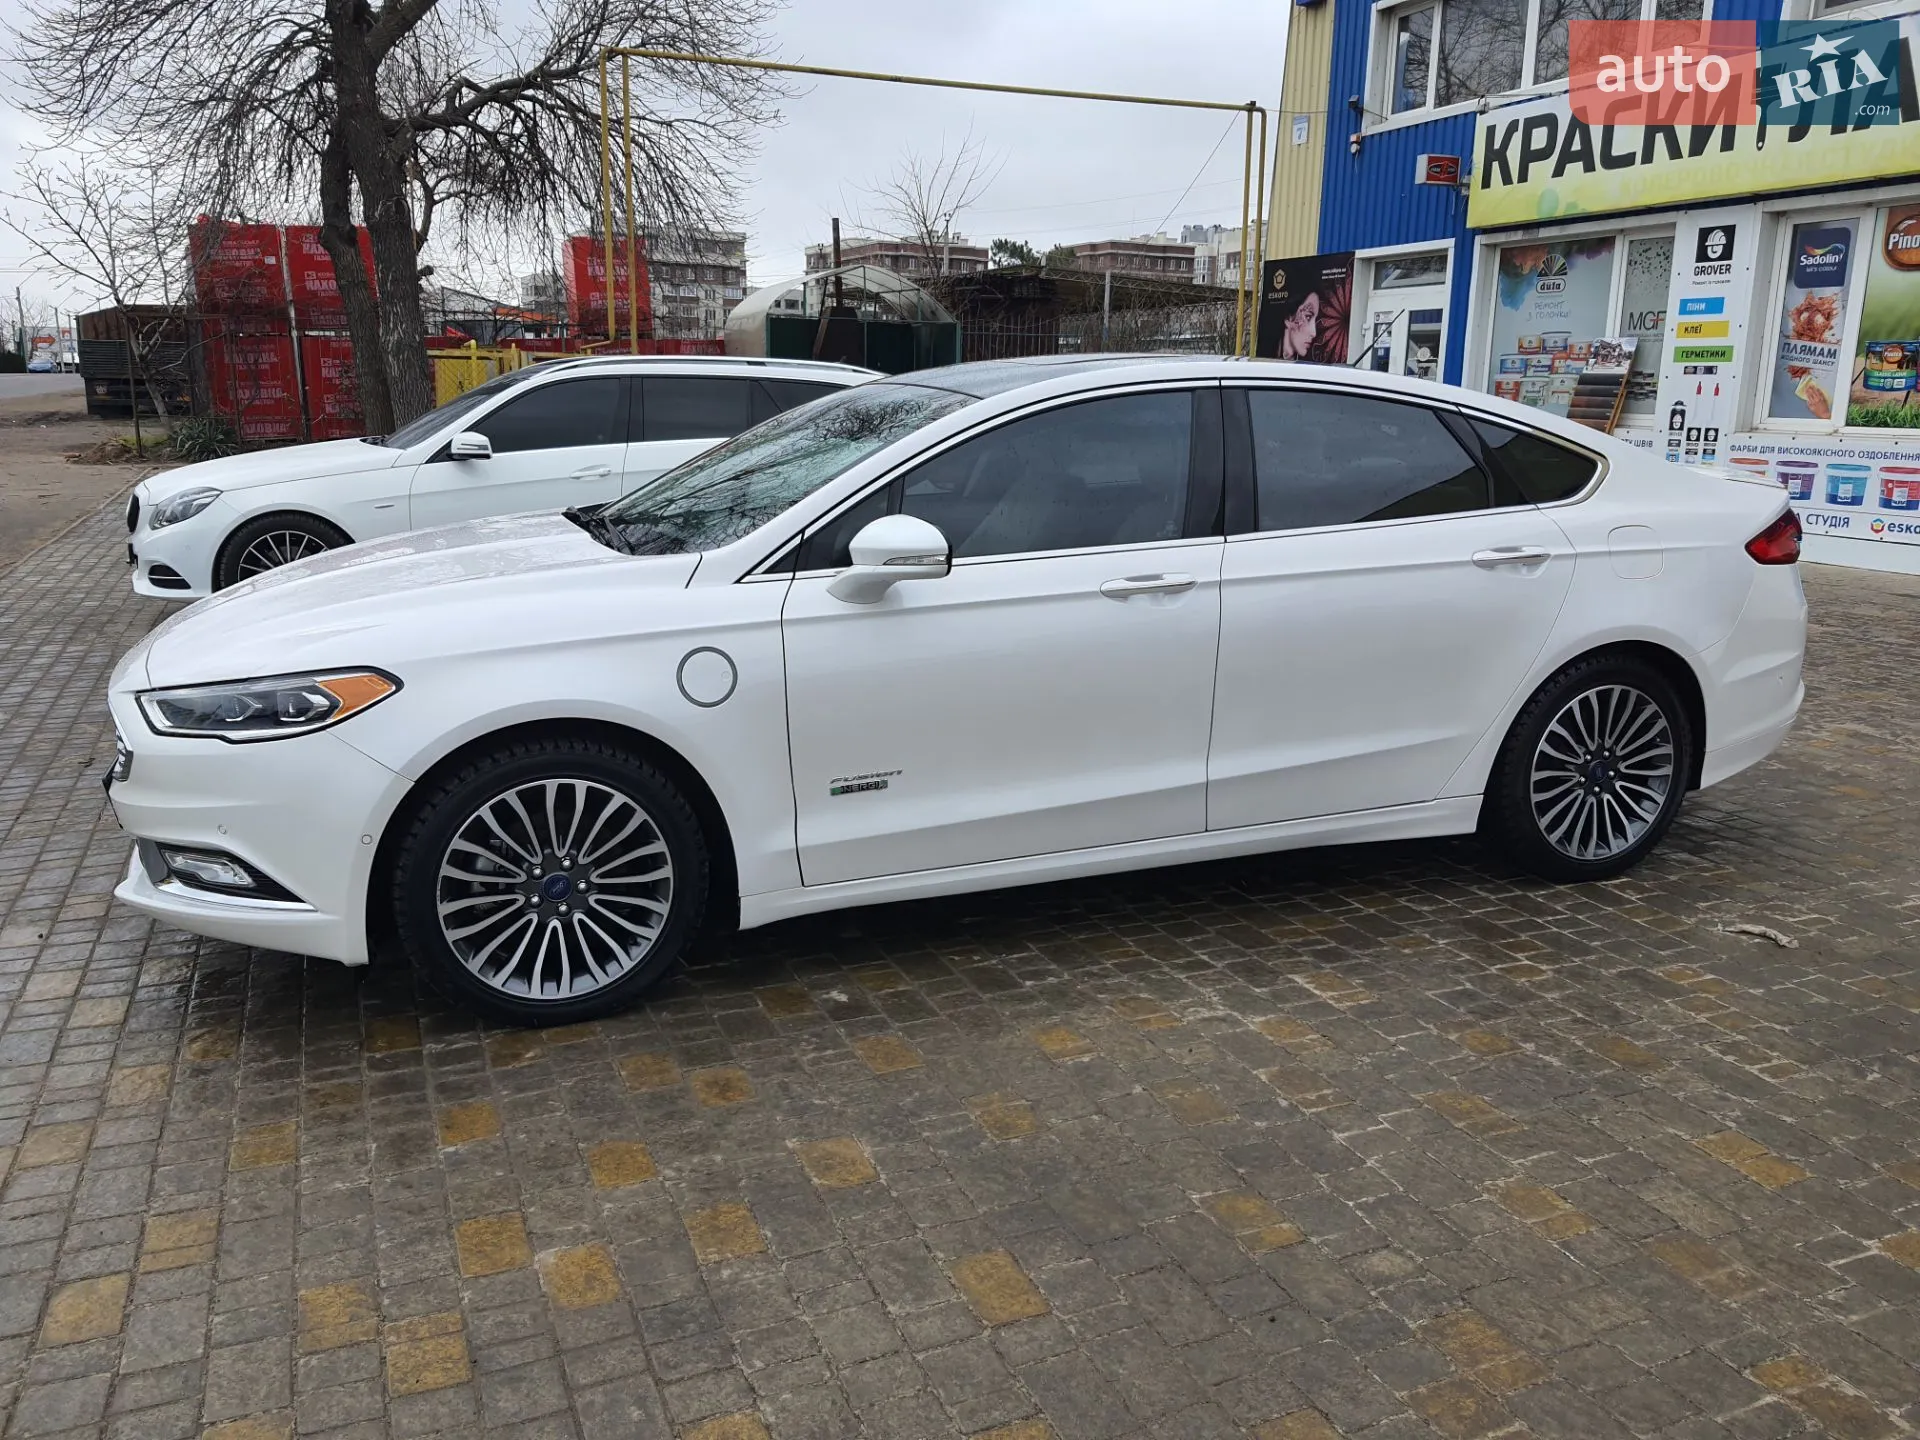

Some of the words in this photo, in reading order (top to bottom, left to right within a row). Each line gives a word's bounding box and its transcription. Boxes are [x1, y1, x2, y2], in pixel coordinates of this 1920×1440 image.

[1480, 73, 1743, 190] КРАСКИ
[1800, 254, 1839, 266] Sadolin
[1693, 264, 1732, 277] GROVER
[1681, 350, 1726, 358] ГЕРМЕТИКИ
[1782, 342, 1837, 359] ПЛЯМАМ
[1729, 444, 1758, 453] ФАРБИ
[1759, 446, 1775, 455] ДЛЯ
[1777, 446, 1855, 459] ВИСОКОЯКІСНОГО
[1857, 450, 1920, 462] ОЗДОБЛЕННЯ
[1806, 513, 1850, 529] СТУДІЯ
